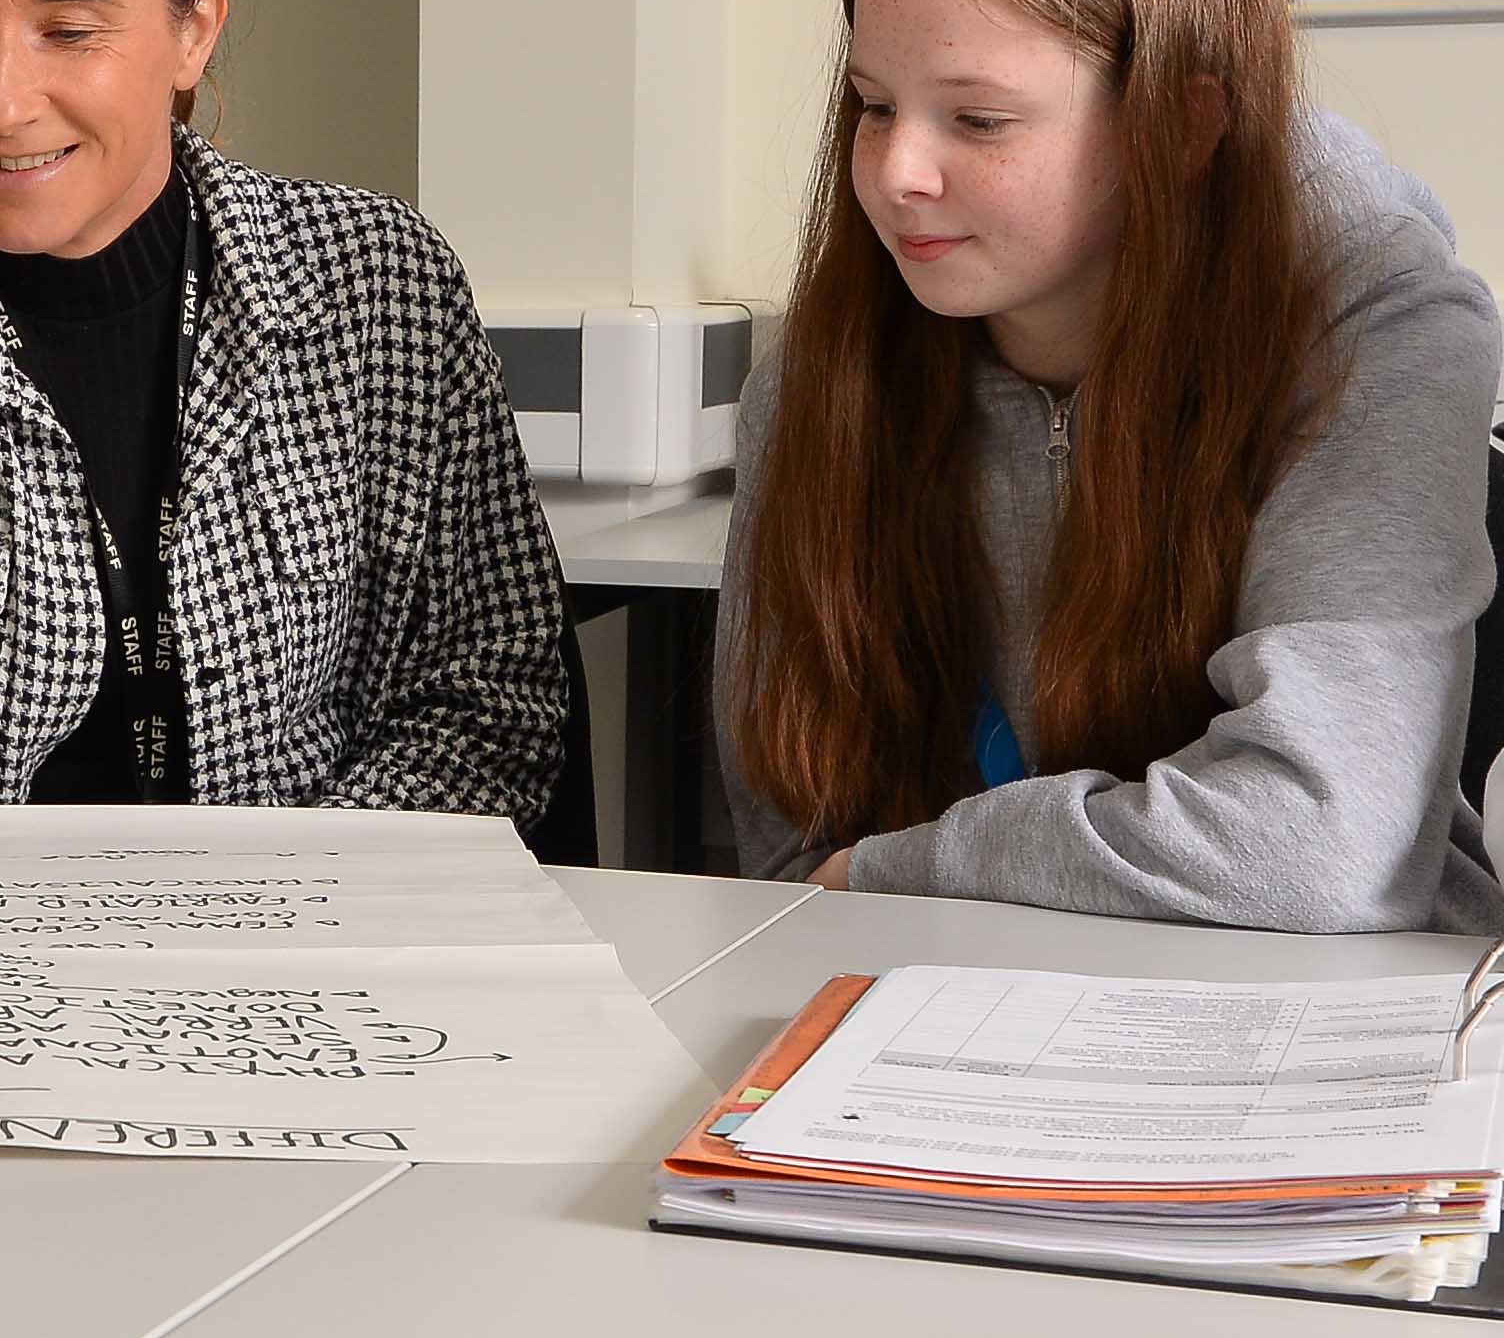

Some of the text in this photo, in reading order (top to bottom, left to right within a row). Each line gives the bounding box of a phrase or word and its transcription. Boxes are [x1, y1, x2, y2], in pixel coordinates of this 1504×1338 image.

[183, 269, 198, 337] STAFF
[158, 496, 174, 563] STAFF
[122, 616, 144, 676] STAFF
[155, 611, 172, 671] STAFF
[150, 714, 168, 780] STAFF
[37, 896, 287, 909] FABRICATED
[118, 921, 293, 930] FEMALE
[82, 1010, 336, 1030] VERBAL
[90, 1025, 352, 1046] SEXUAL
[53, 1056, 368, 1079] PHYSICAL
